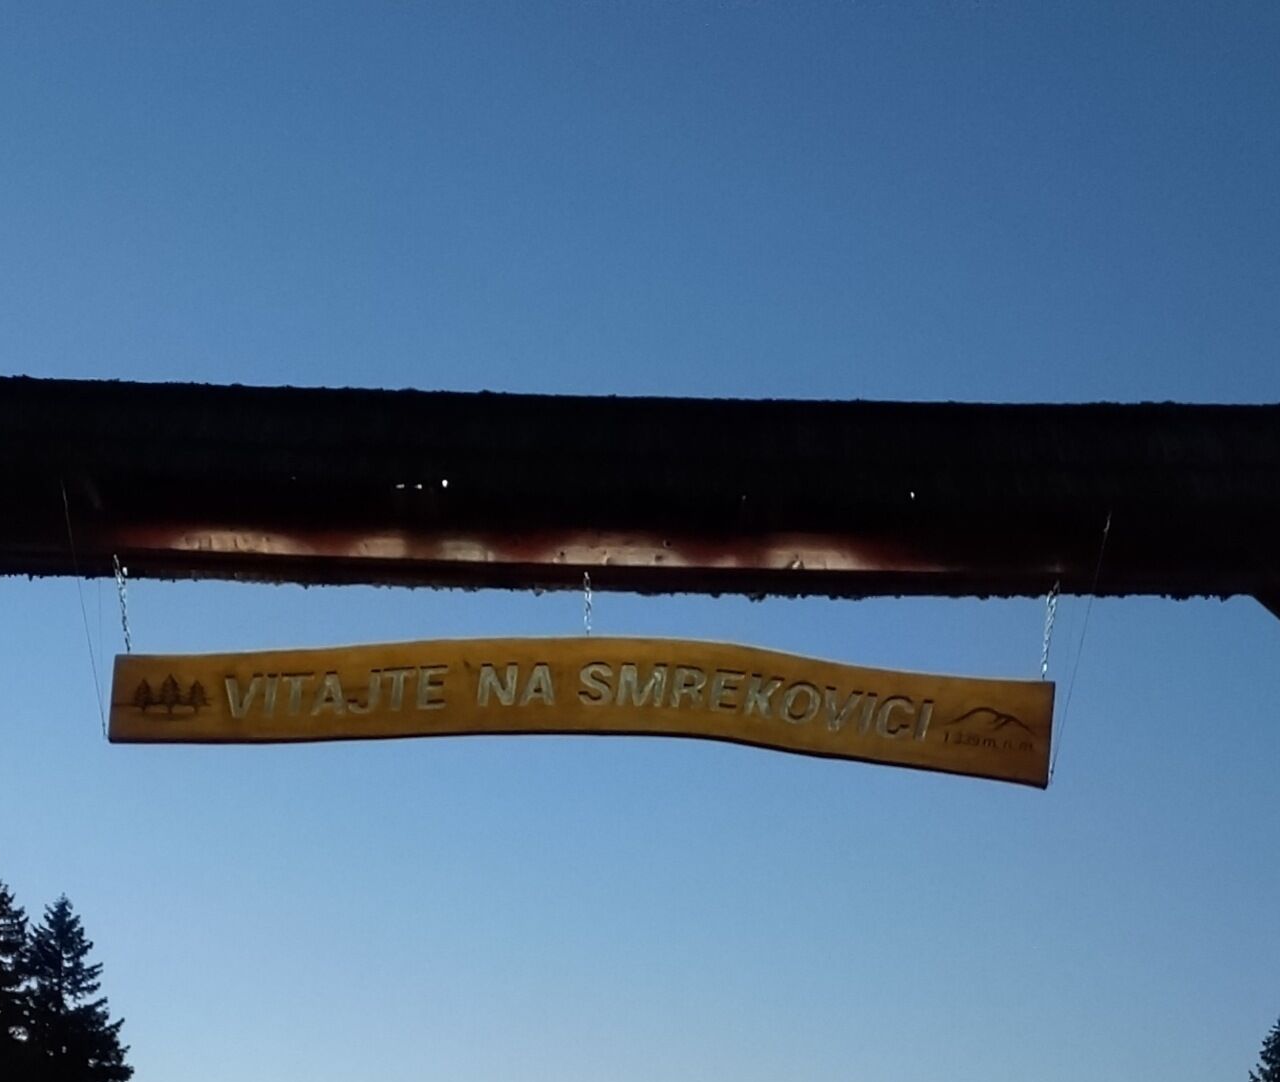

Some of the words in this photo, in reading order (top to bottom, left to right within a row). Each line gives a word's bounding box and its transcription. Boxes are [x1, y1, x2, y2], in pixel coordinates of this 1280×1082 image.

[223, 665, 449, 719] VITAJTE
[477, 662, 557, 706] NA
[578, 663, 936, 743] SMREKOVICI
